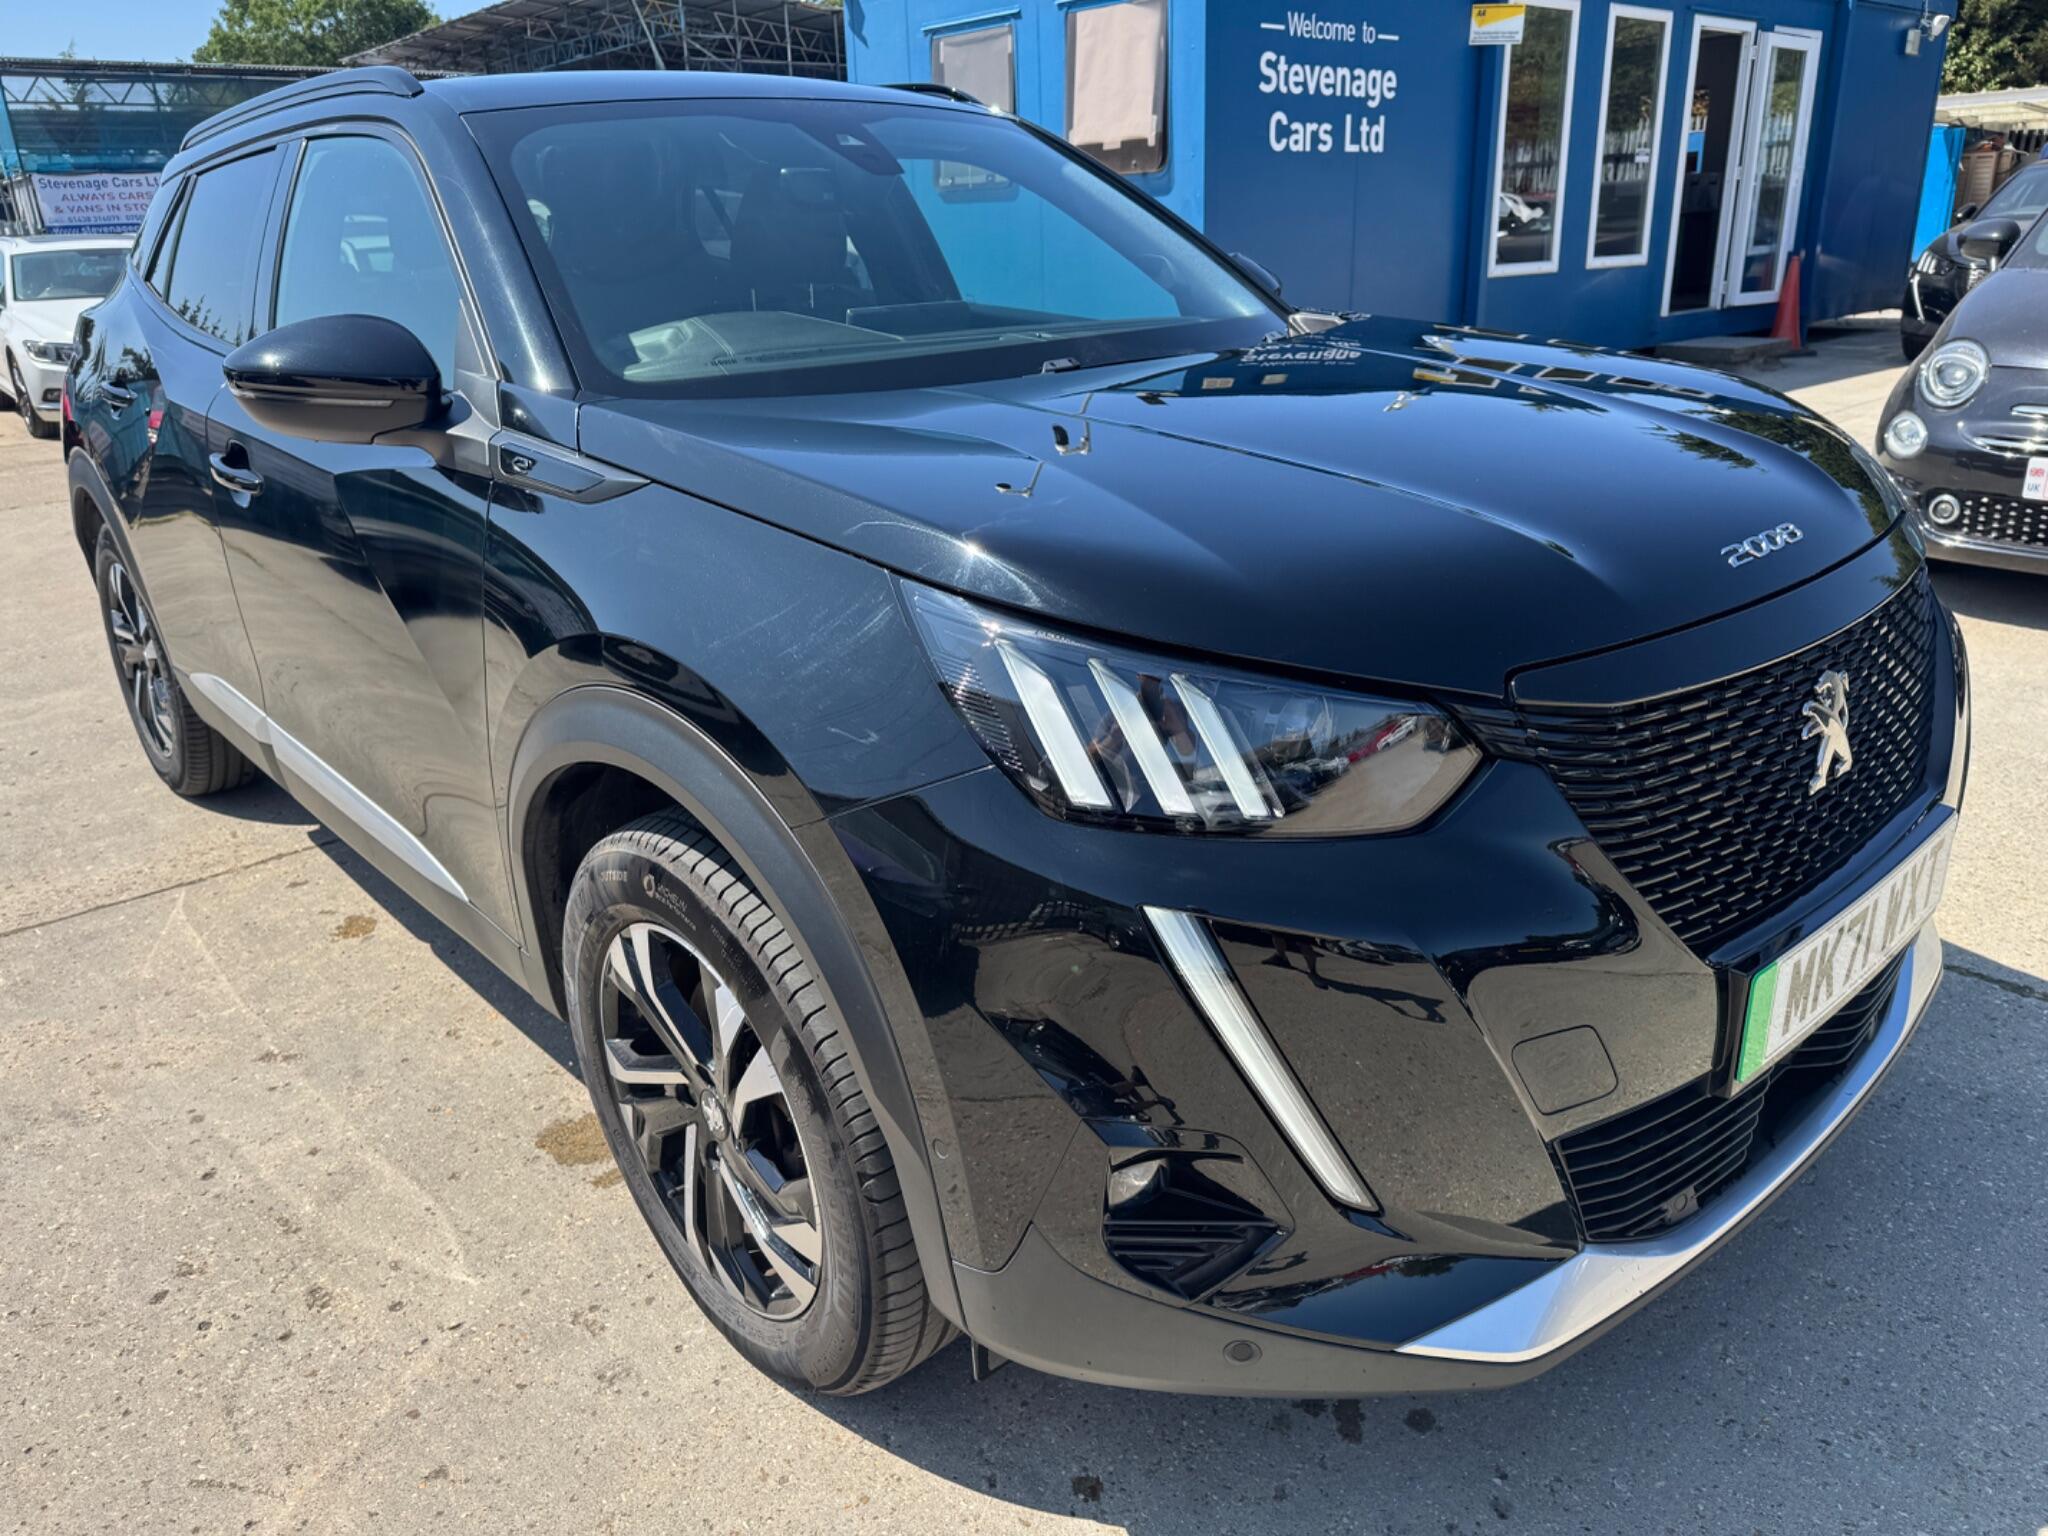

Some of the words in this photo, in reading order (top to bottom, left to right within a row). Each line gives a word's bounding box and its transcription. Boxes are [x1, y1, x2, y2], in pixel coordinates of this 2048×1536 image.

[1287, 11, 1356, 42] Welcome
[1362, 21, 1376, 44] to
[1259, 51, 1397, 108] Stevenage
[1269, 111, 1333, 152] Cars
[1344, 113, 1386, 153] Ltd
[38, 177, 109, 191] Stevenage
[112, 176, 143, 188] Cars
[145, 175, 160, 187] Lt
[61, 191, 116, 202] ALWAYS
[118, 191, 153, 201] CARS
[67, 204, 103, 213] VANS
[107, 203, 120, 212] IN
[124, 202, 148, 212] STO
[1720, 522, 1803, 568] 2008
[1782, 898, 1879, 1036] MK71
